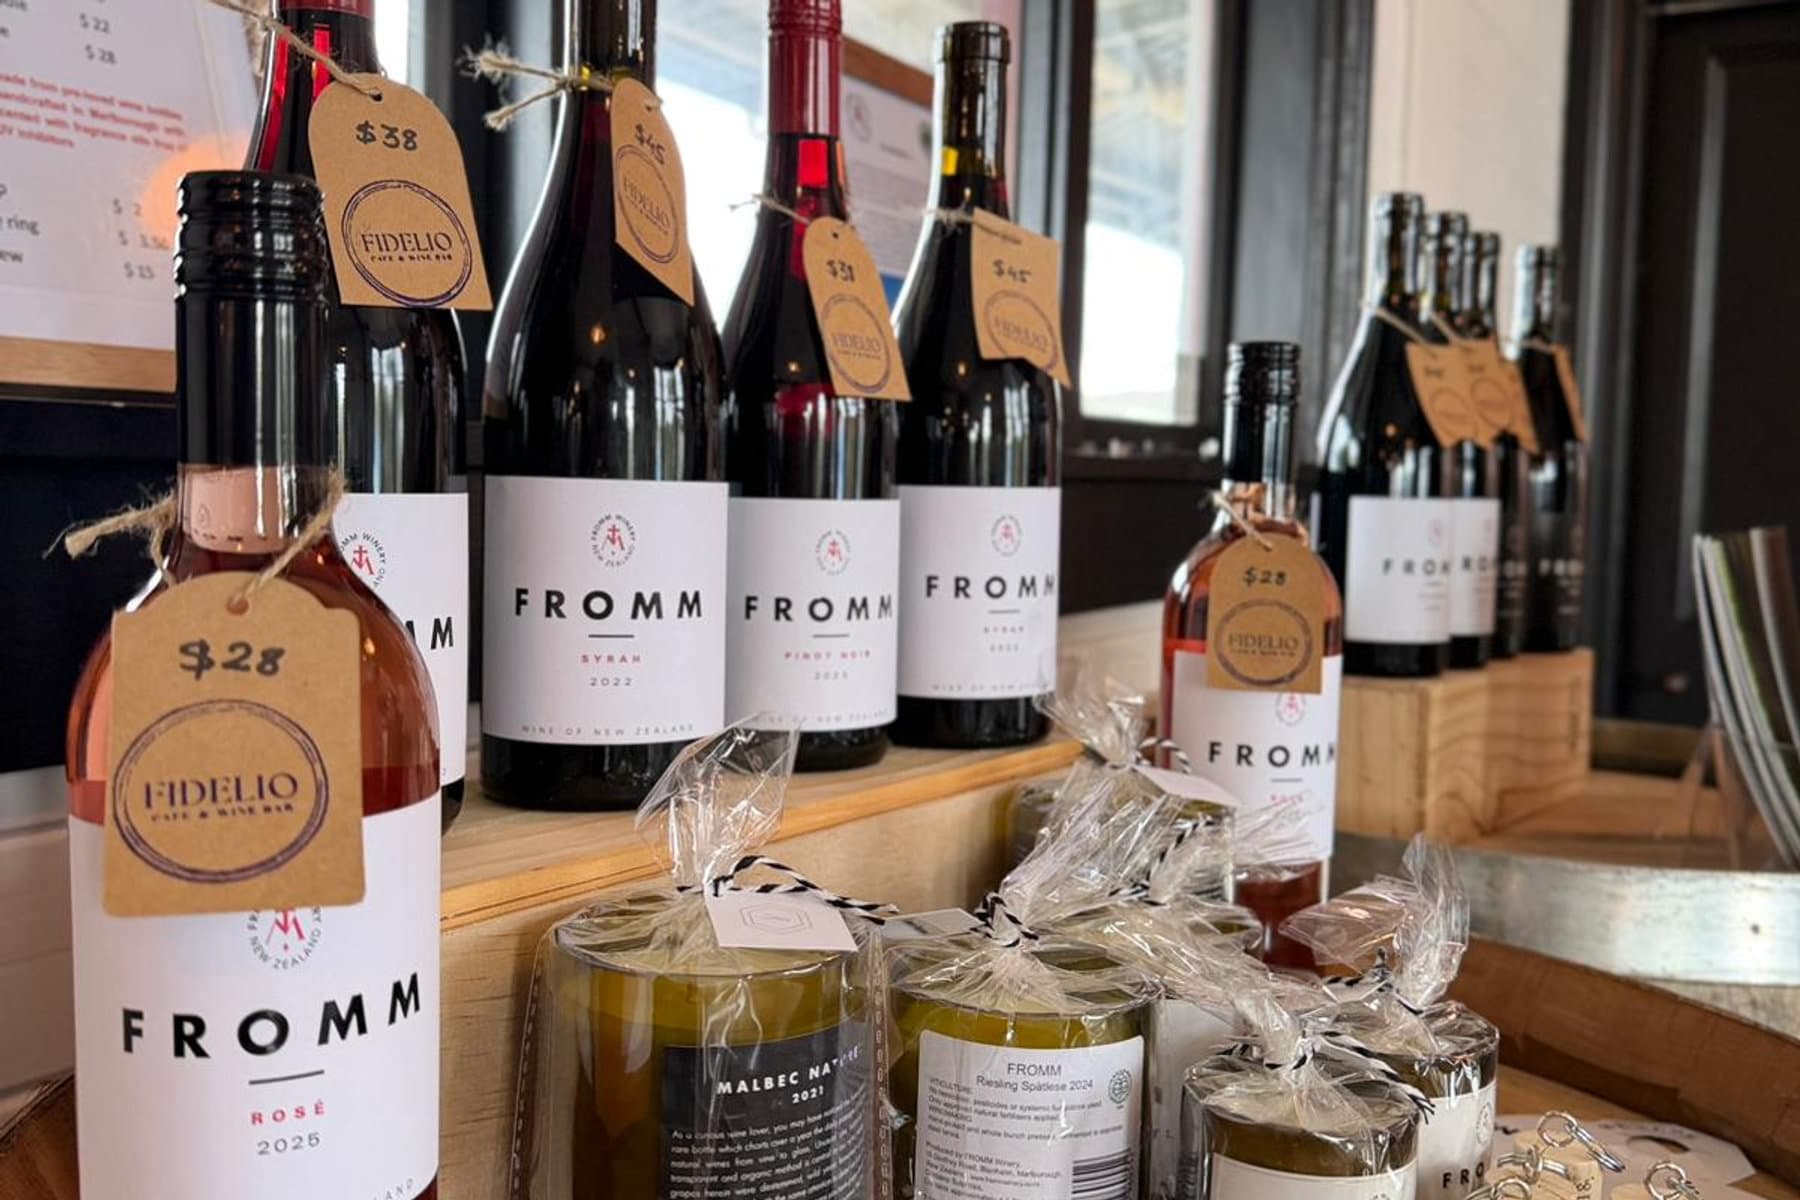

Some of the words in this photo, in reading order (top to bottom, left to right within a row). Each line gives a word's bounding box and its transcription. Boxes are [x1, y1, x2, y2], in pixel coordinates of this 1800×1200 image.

[356, 120, 418, 151] $38
[7, 216, 40, 236] ring
[361, 232, 452, 252] FIDELIO
[1243, 566, 1286, 588] $28
[515, 587, 702, 621] FROMM
[744, 594, 893, 622] FROMM
[1227, 633, 1299, 652] FIDELIO
[178, 638, 285, 680] $28
[580, 654, 642, 664] SYRAH
[589, 677, 633, 687] 2022
[144, 772, 299, 809] FIDELIO
[122, 972, 421, 1060] FROMM
[1007, 1062, 1062, 1077] FROMM
[716, 1071, 799, 1095] MALBEC
[792, 1085, 824, 1104] 2021
[1069, 1079, 1093, 1091] 2024
[251, 1099, 326, 1126] ROSÉ
[257, 1132, 321, 1156] 2025
